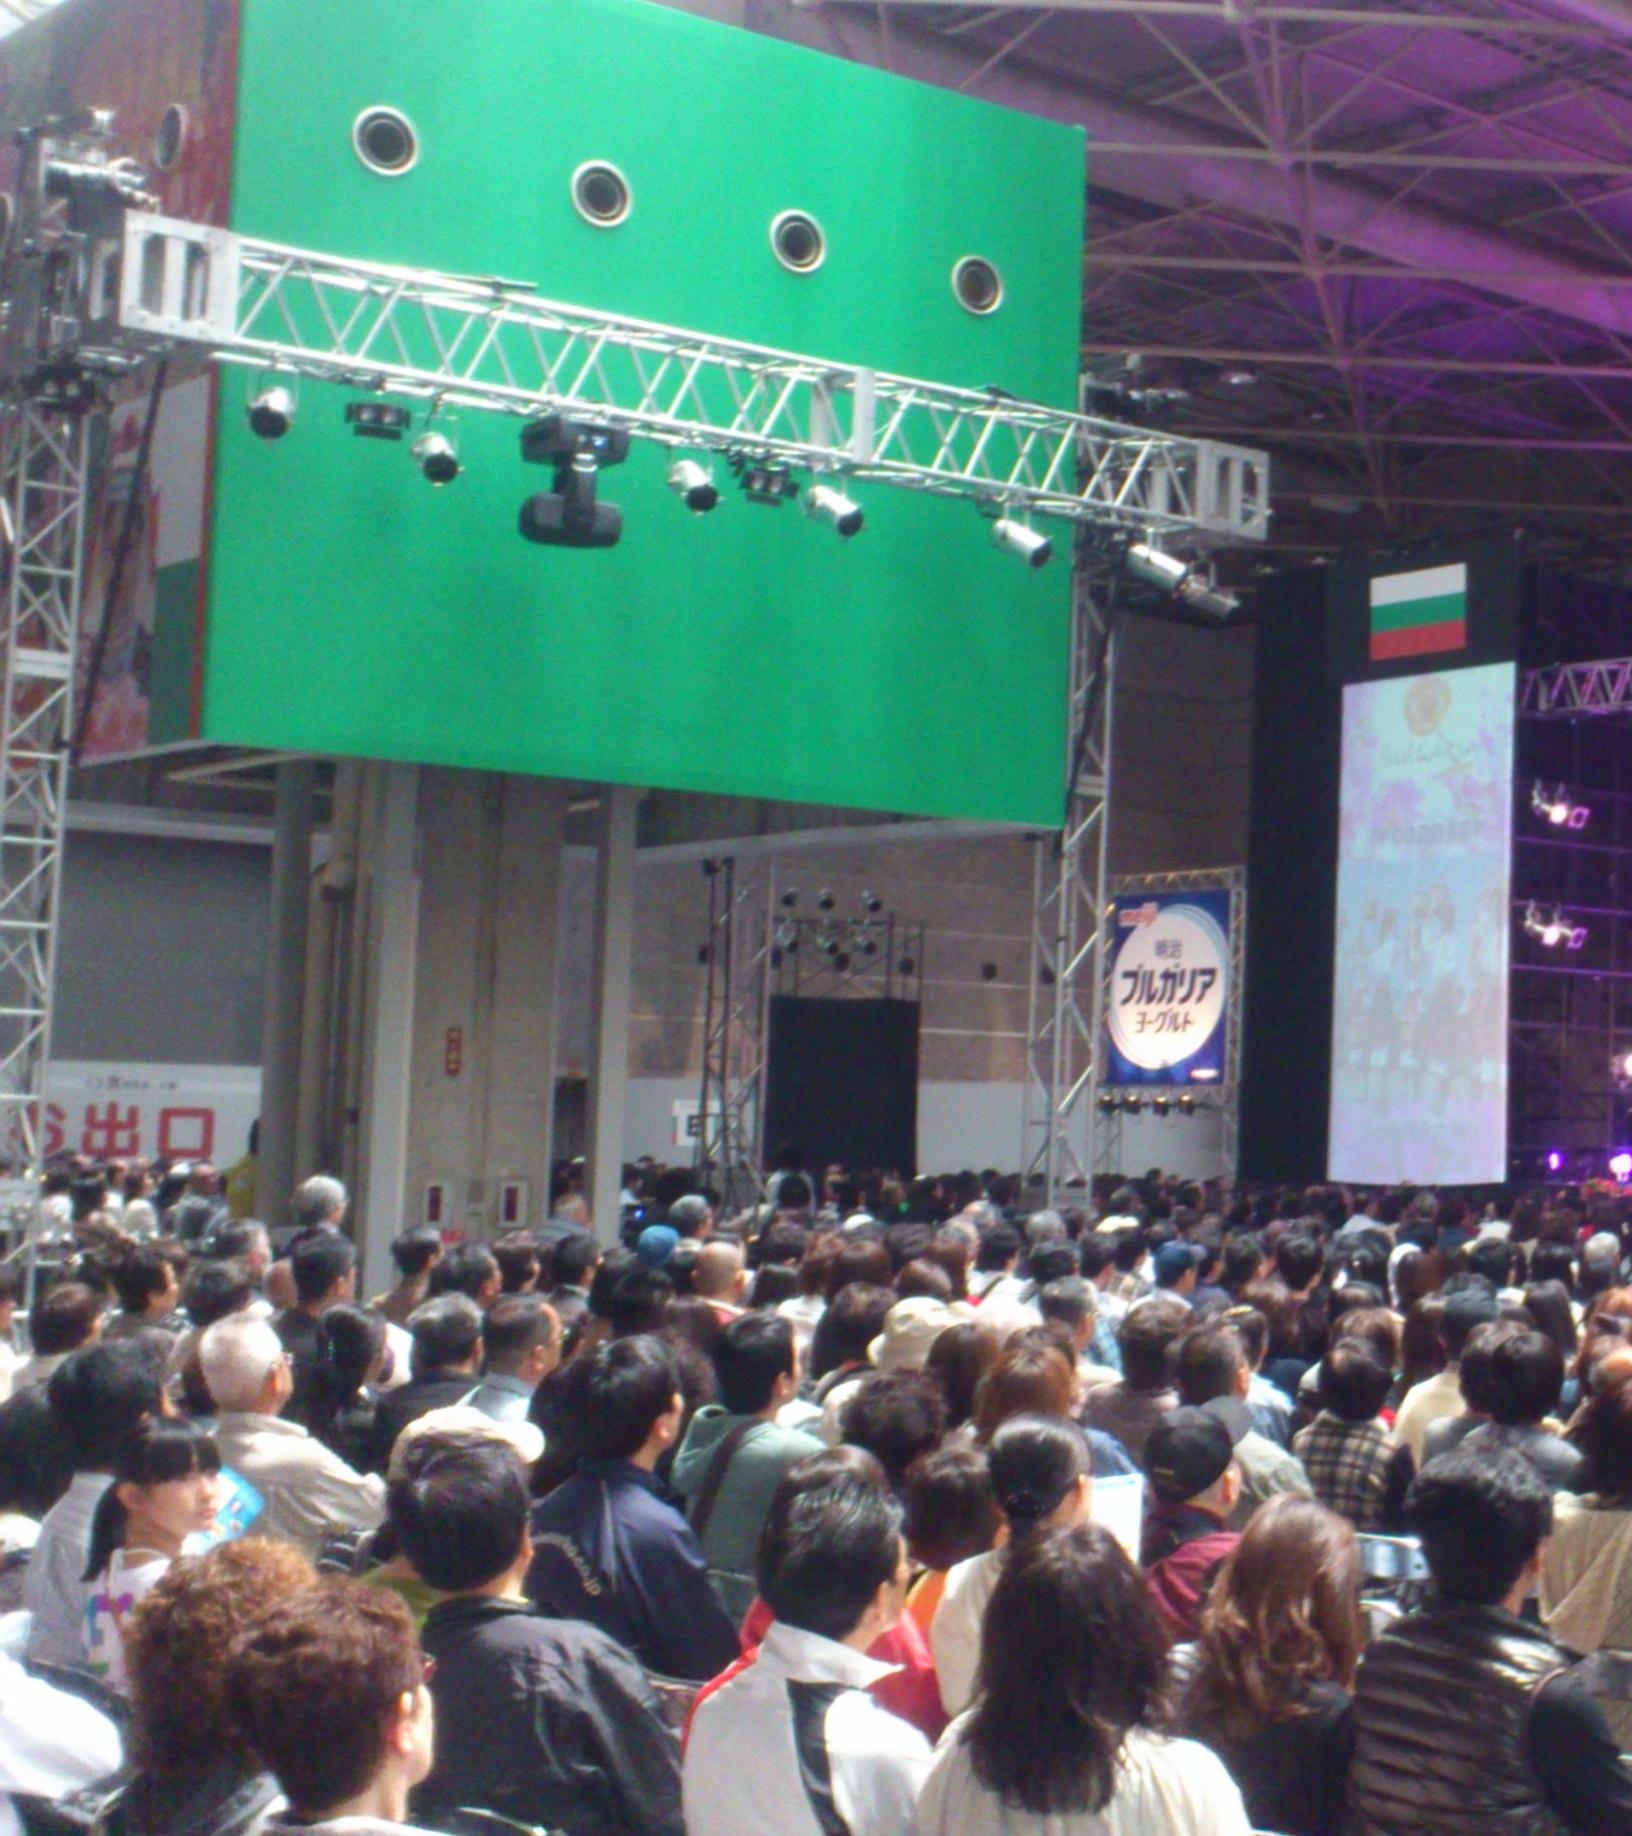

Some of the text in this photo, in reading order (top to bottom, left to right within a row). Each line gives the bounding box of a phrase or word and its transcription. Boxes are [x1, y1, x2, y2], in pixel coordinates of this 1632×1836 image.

[1120, 962, 1218, 1006] ブルガリア
[1134, 1008, 1195, 1033] ヨーグルト
